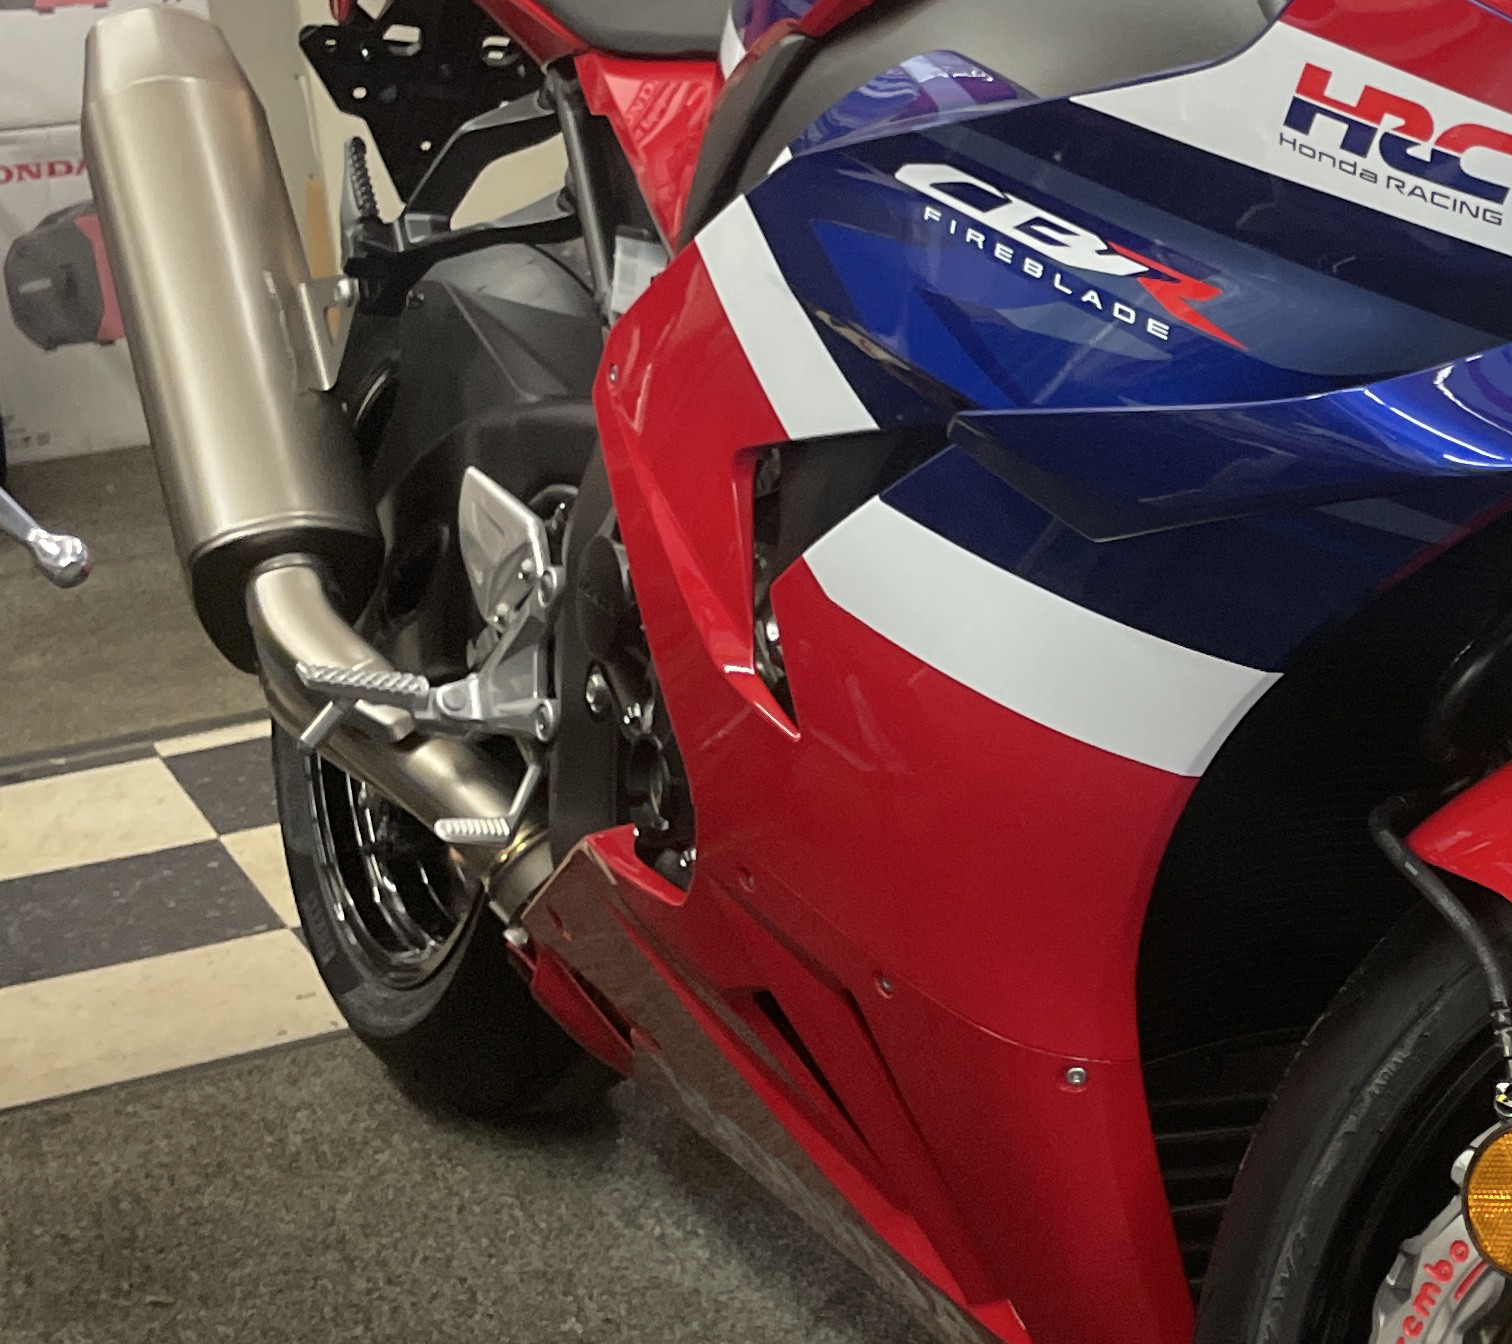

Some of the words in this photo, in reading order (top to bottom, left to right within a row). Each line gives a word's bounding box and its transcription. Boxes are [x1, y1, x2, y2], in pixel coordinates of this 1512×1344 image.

[1279, 131, 1378, 184] Honda
[1385, 175, 1504, 227] RACING
[922, 205, 1170, 342] FIREBLADE
